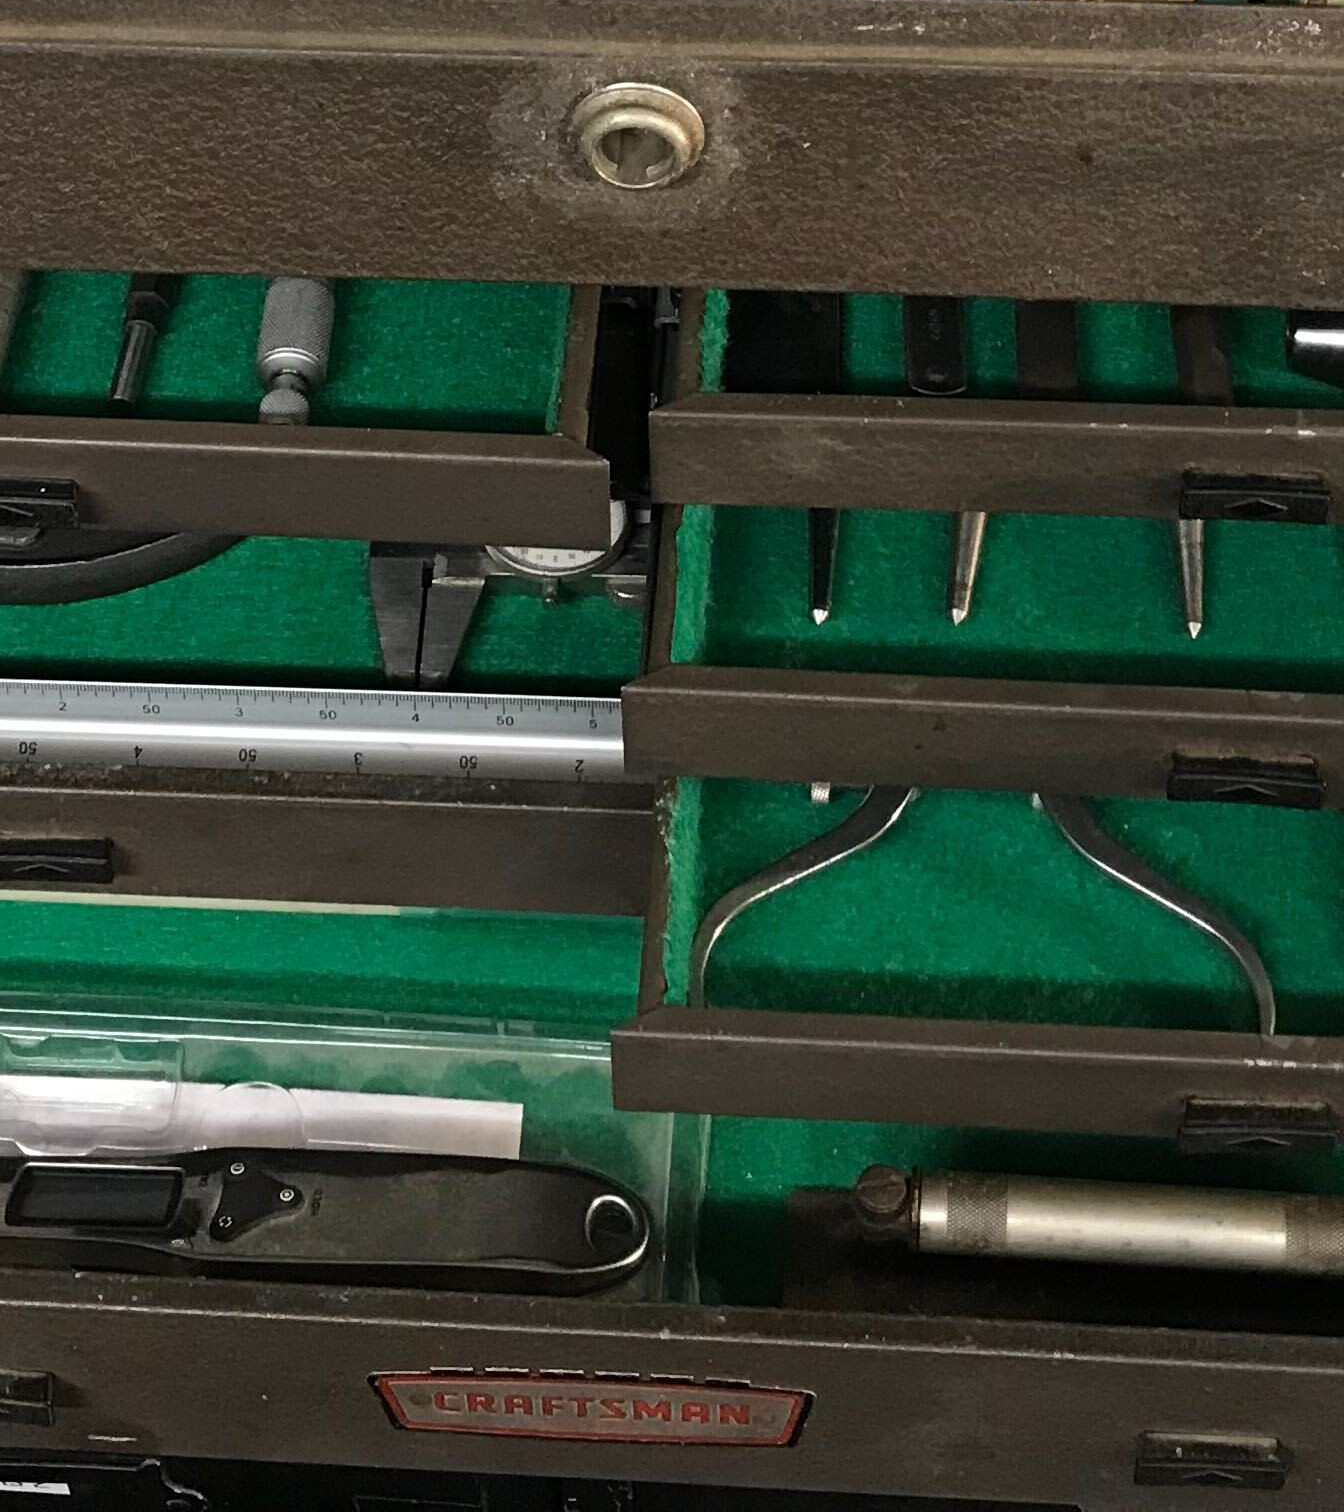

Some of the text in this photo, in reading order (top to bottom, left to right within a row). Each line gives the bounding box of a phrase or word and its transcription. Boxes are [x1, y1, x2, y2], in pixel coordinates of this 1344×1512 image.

[59, 701, 67, 711] 2
[142, 704, 161, 714] 50
[235, 707, 244, 717] 3
[319, 710, 337, 720] 50
[411, 713, 420, 722] 4
[496, 716, 514, 726] 50
[589, 719, 598, 729] 5
[18, 741, 37, 755] 50
[133, 745, 143, 758] 4
[238, 749, 257, 762] 50
[353, 753, 362, 764] 3
[459, 755, 478, 769] 50
[574, 760, 584, 772] 2
[433, 1392, 752, 1426] CRAFTSMAN
